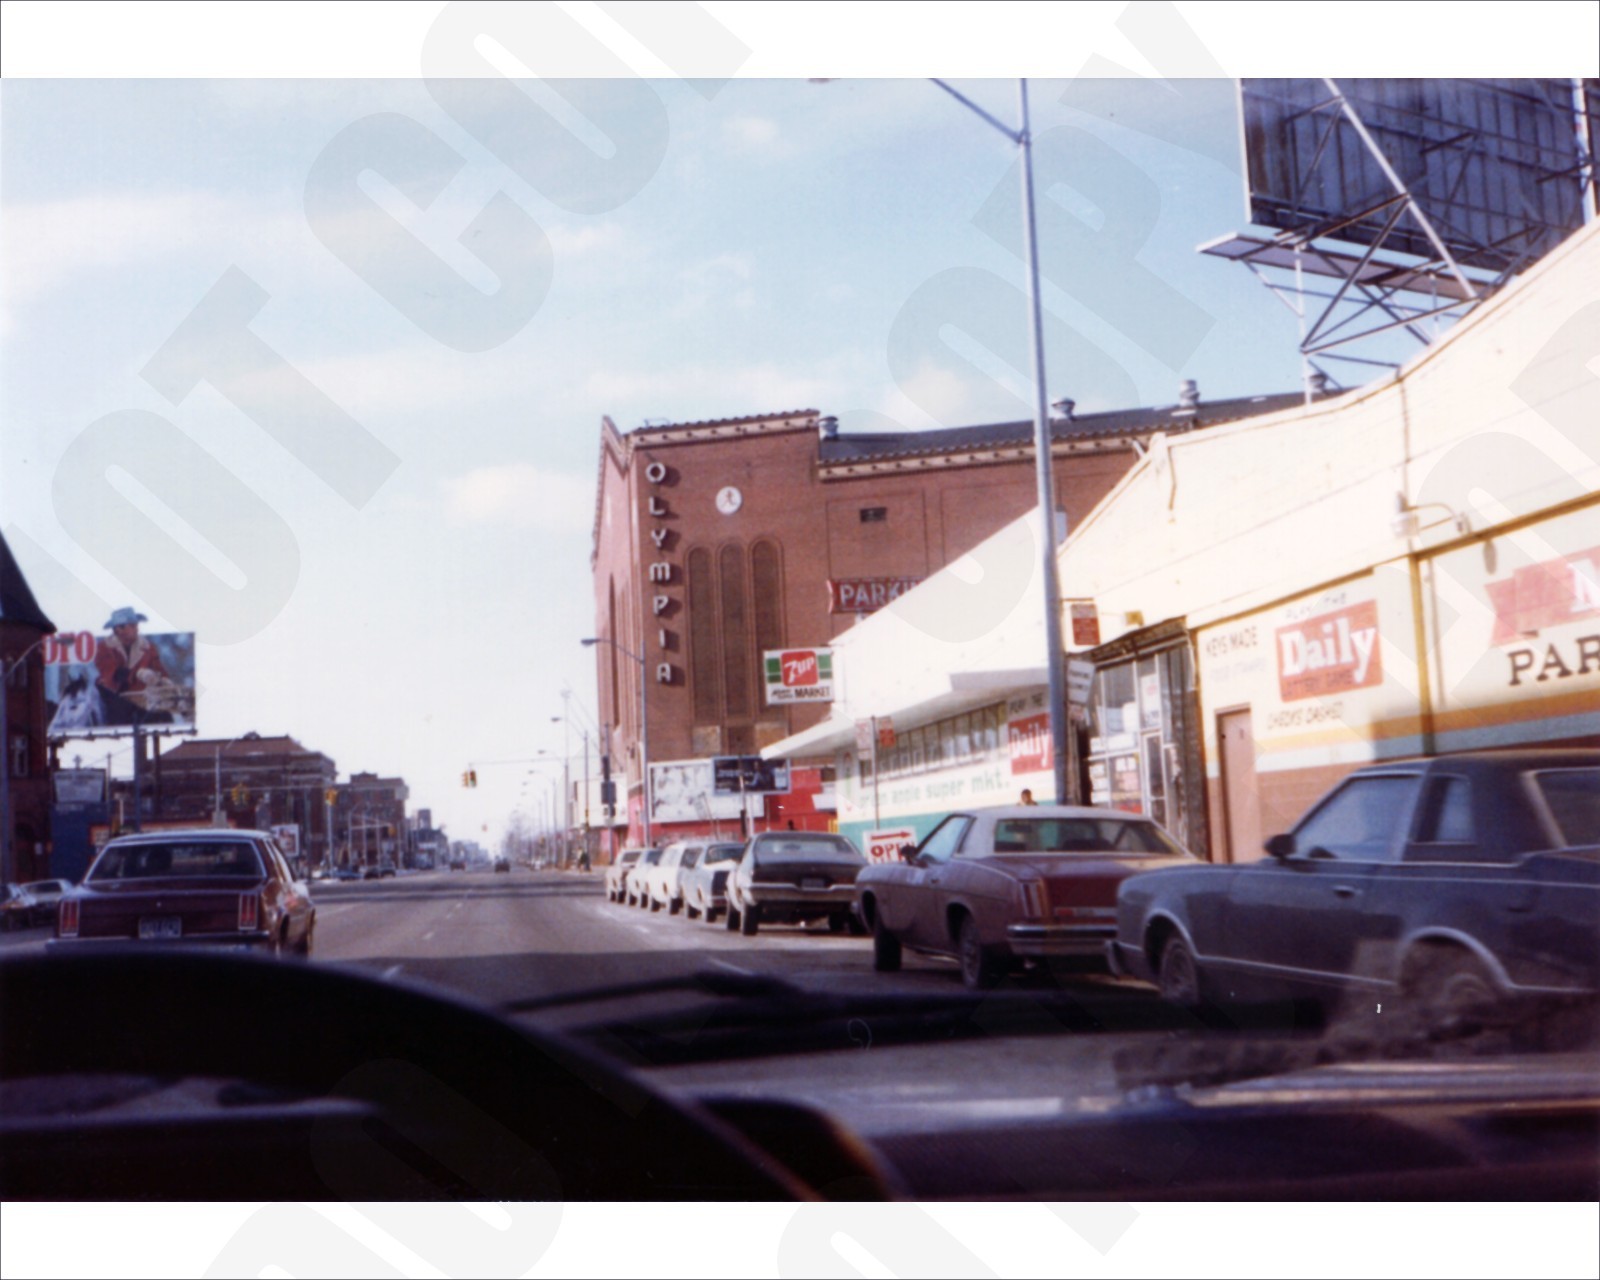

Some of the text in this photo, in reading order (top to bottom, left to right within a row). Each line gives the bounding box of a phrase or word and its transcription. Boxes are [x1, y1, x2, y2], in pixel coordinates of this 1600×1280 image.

[645, 461, 671, 683] OLYMPIA
[1231, 625, 1258, 649] MADE
[1279, 617, 1377, 684] Daily
[795, 687, 830, 699] MARKET
[1010, 721, 1052, 768] Daily
[926, 778, 966, 801] super
[971, 766, 1010, 794] mkt.
